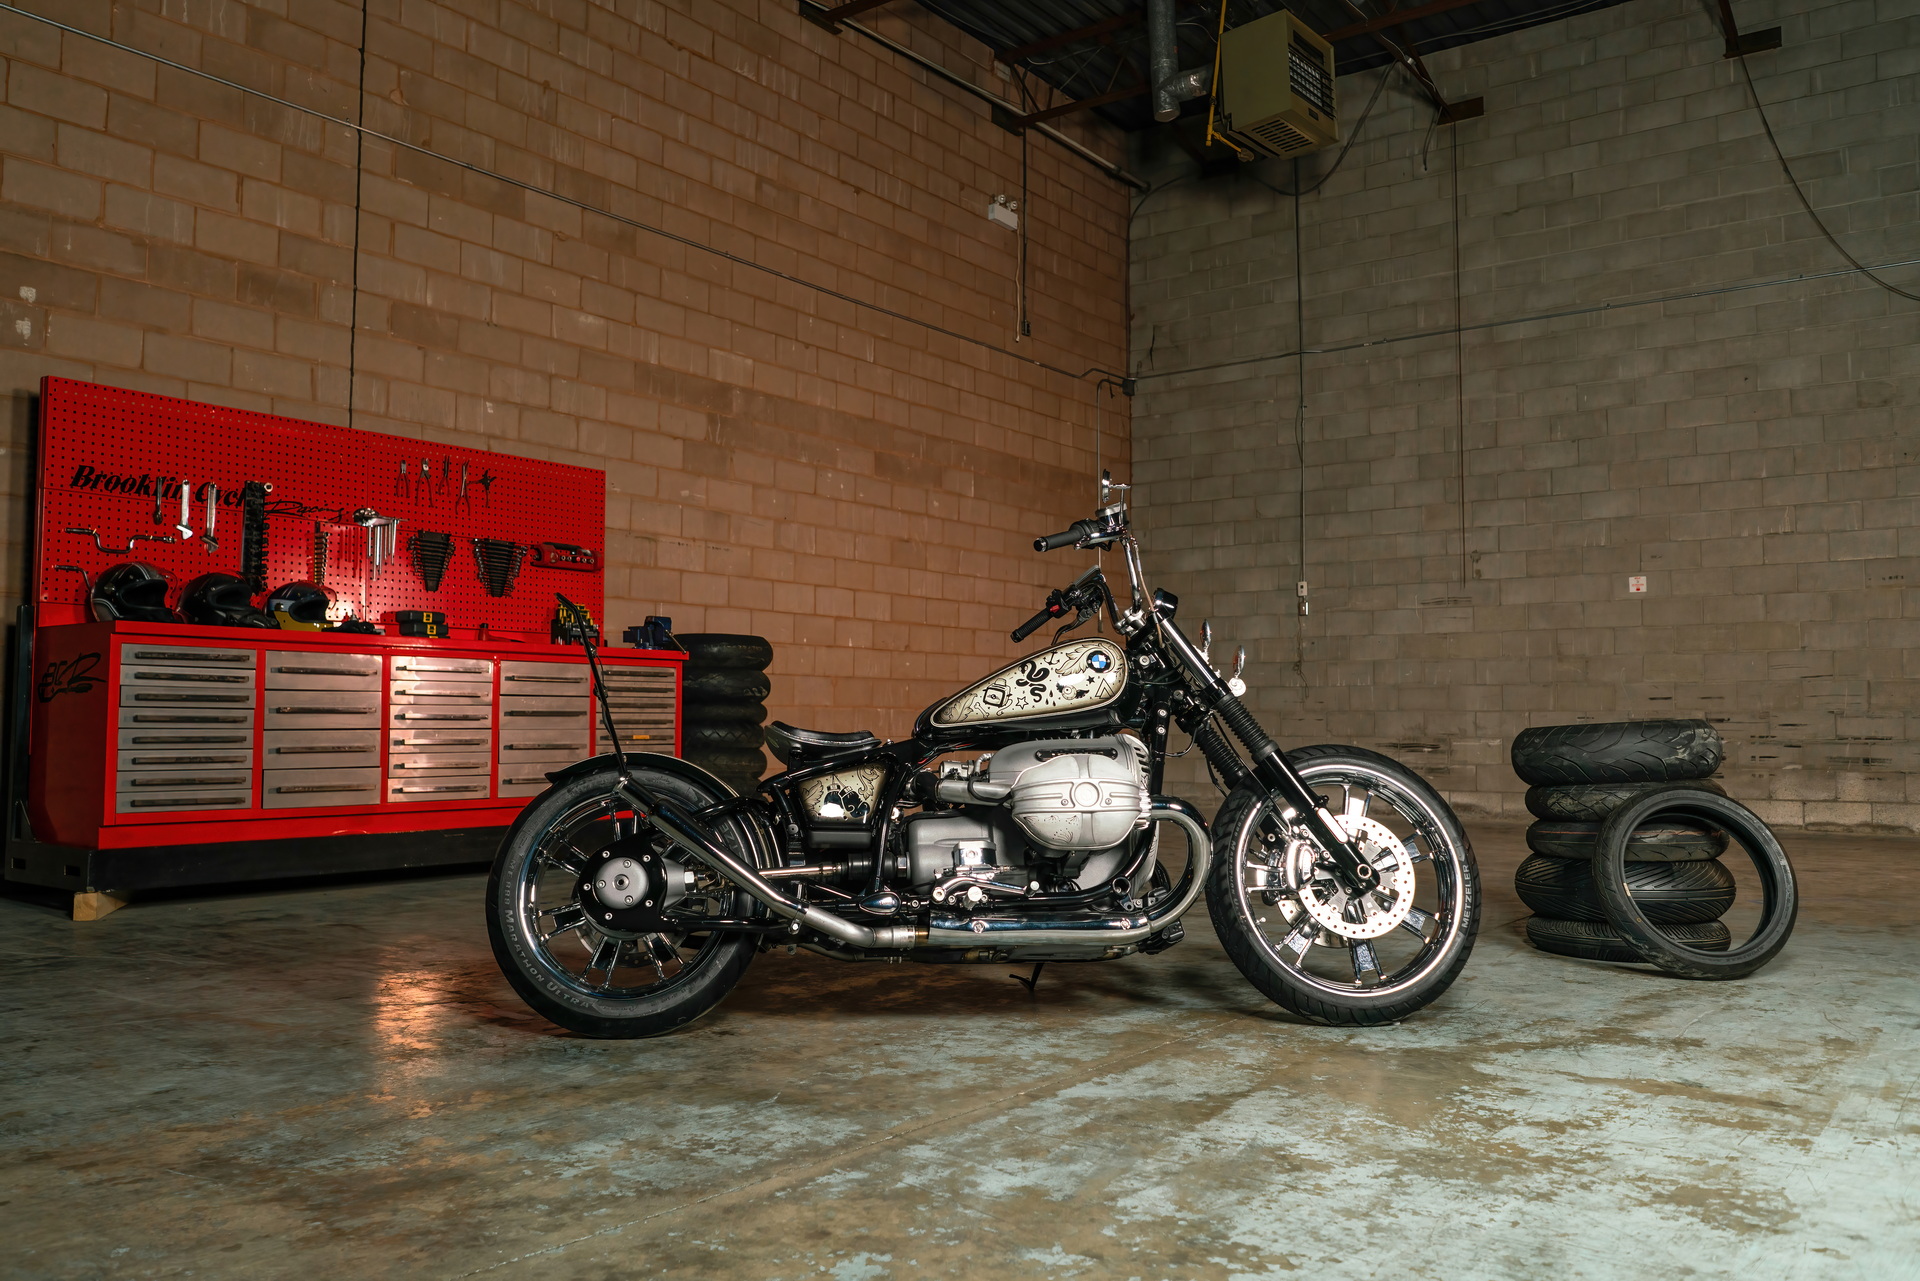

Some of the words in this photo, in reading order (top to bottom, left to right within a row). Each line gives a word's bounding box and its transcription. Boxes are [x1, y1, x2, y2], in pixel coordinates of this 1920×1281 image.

[1229, 839, 1237, 895] MARATHON
[1461, 863, 1471, 929] METZELER
[504, 909, 546, 985] MARATHON
[546, 982, 591, 1009] ULTRA
